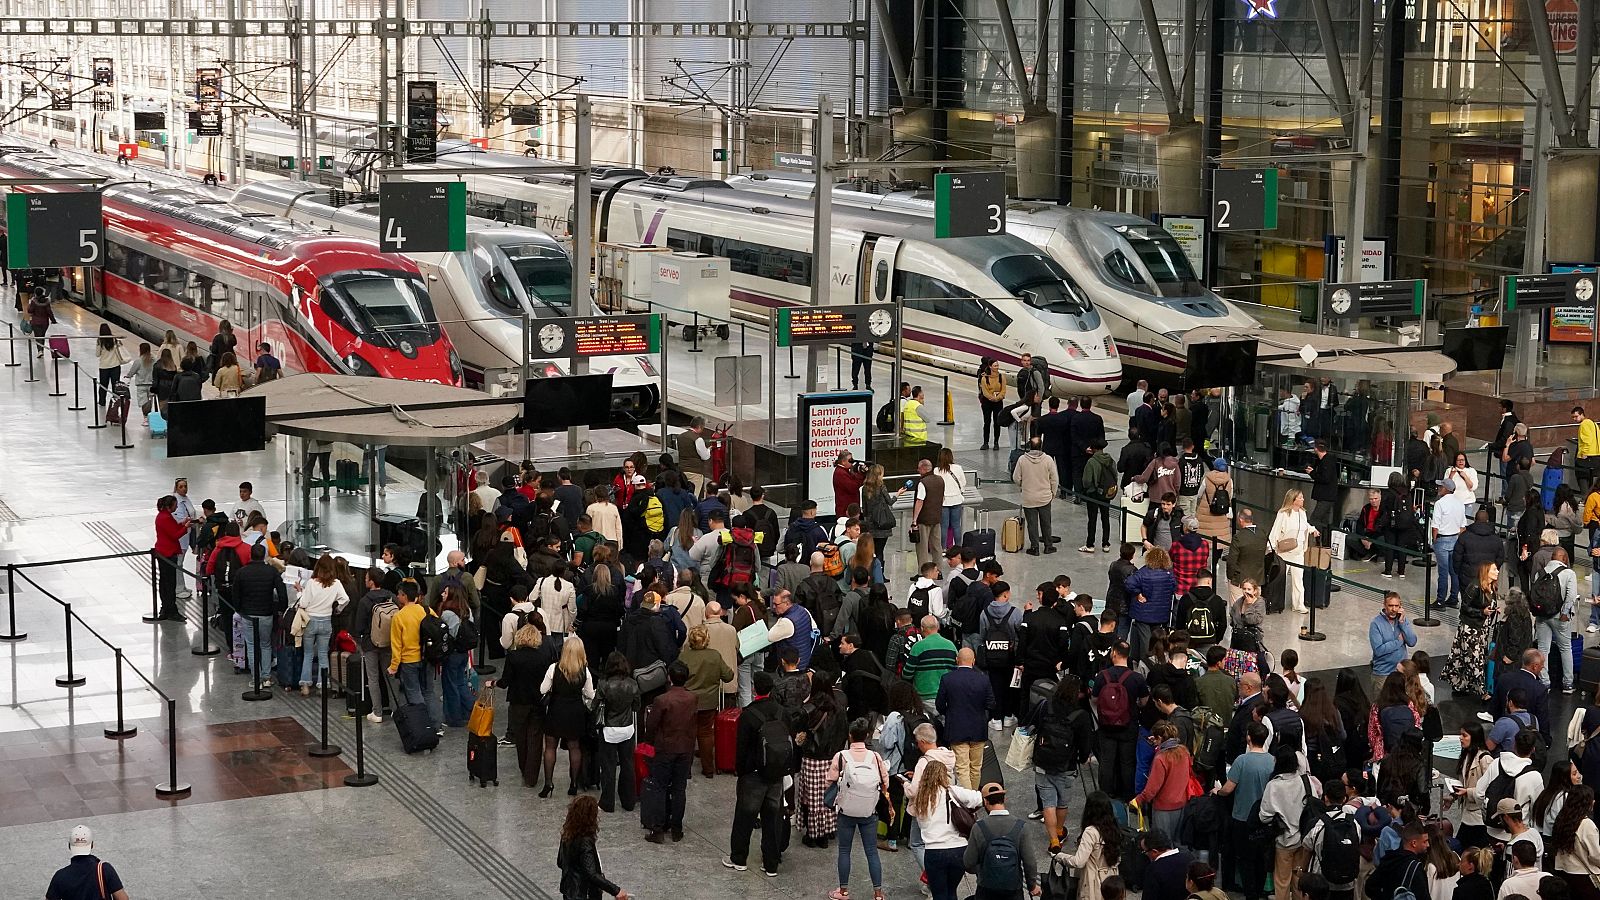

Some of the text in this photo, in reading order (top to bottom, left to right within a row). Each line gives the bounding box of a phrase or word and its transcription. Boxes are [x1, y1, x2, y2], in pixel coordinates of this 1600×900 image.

[1119, 172, 1159, 189] WORK
[435, 186, 446, 194] Vía
[30, 198, 42, 206] Vía
[987, 204, 1002, 234] 3
[1217, 200, 1230, 228] 2
[385, 217, 407, 249] 4
[79, 229, 99, 263] 5
[660, 267, 680, 280] serveo
[831, 272, 855, 287] AVE
[811, 406, 848, 417] Lamine
[811, 416, 860, 427] saldrá por
[811, 427, 854, 437] Madrid y
[811, 436, 862, 447] dormirá en
[811, 448, 849, 458] nuest
[985, 640, 1010, 651] VANS
